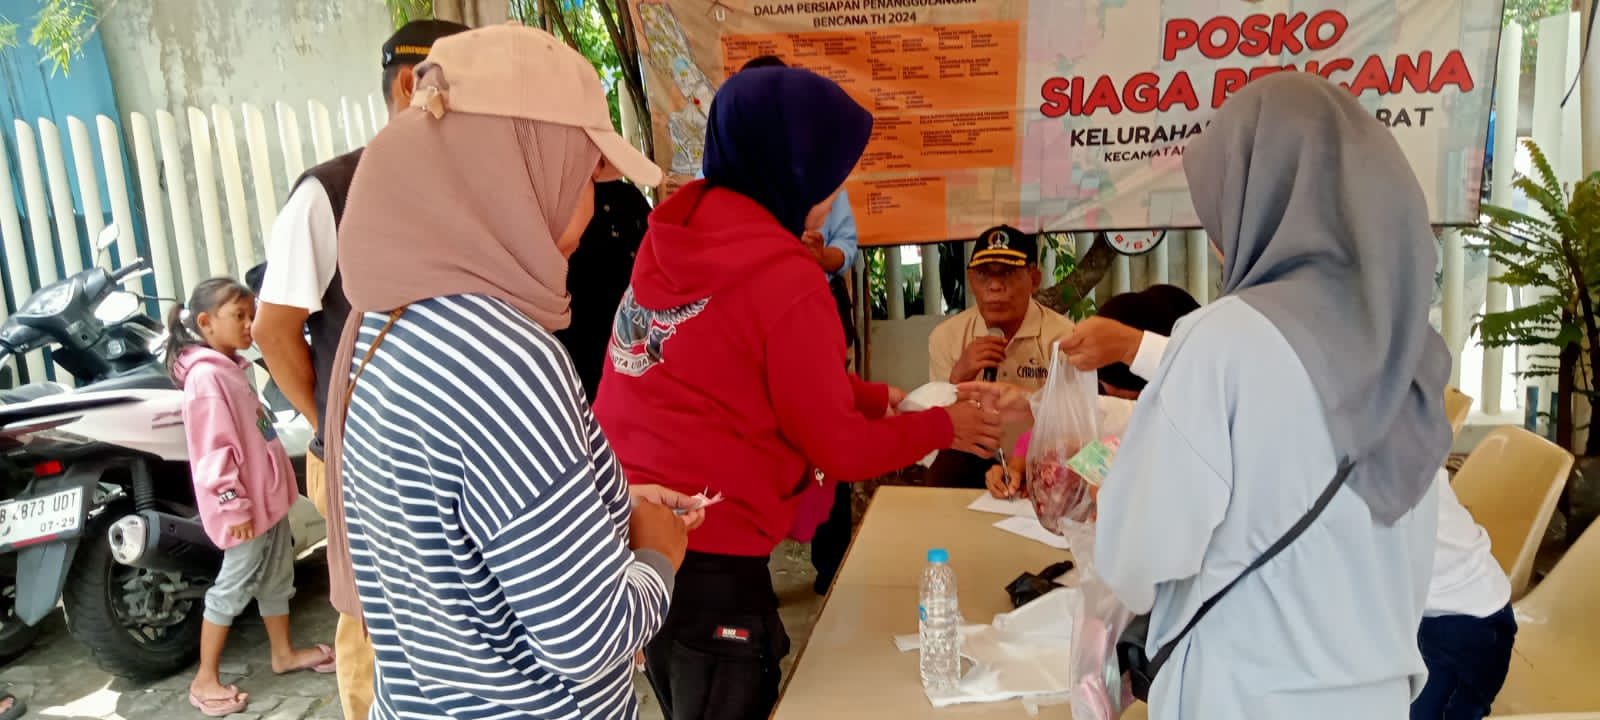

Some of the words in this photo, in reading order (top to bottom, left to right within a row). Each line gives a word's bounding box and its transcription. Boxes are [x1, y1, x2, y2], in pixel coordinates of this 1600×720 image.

[753, 5, 795, 17] DALAM
[796, 1, 861, 14] PERSIAPAN
[863, 0, 978, 10] PENANGGULA
[813, 16, 868, 28] BENCANA
[870, 14, 886, 25] TH
[888, 12, 917, 24] 2024
[1162, 10, 1349, 61] POSKO
[1040, 71, 1200, 118] SIAGA
[1211, 50, 1474, 109] BCANA
[1070, 120, 1211, 147] KELURAHA
[53, 492, 77, 512] UDT
